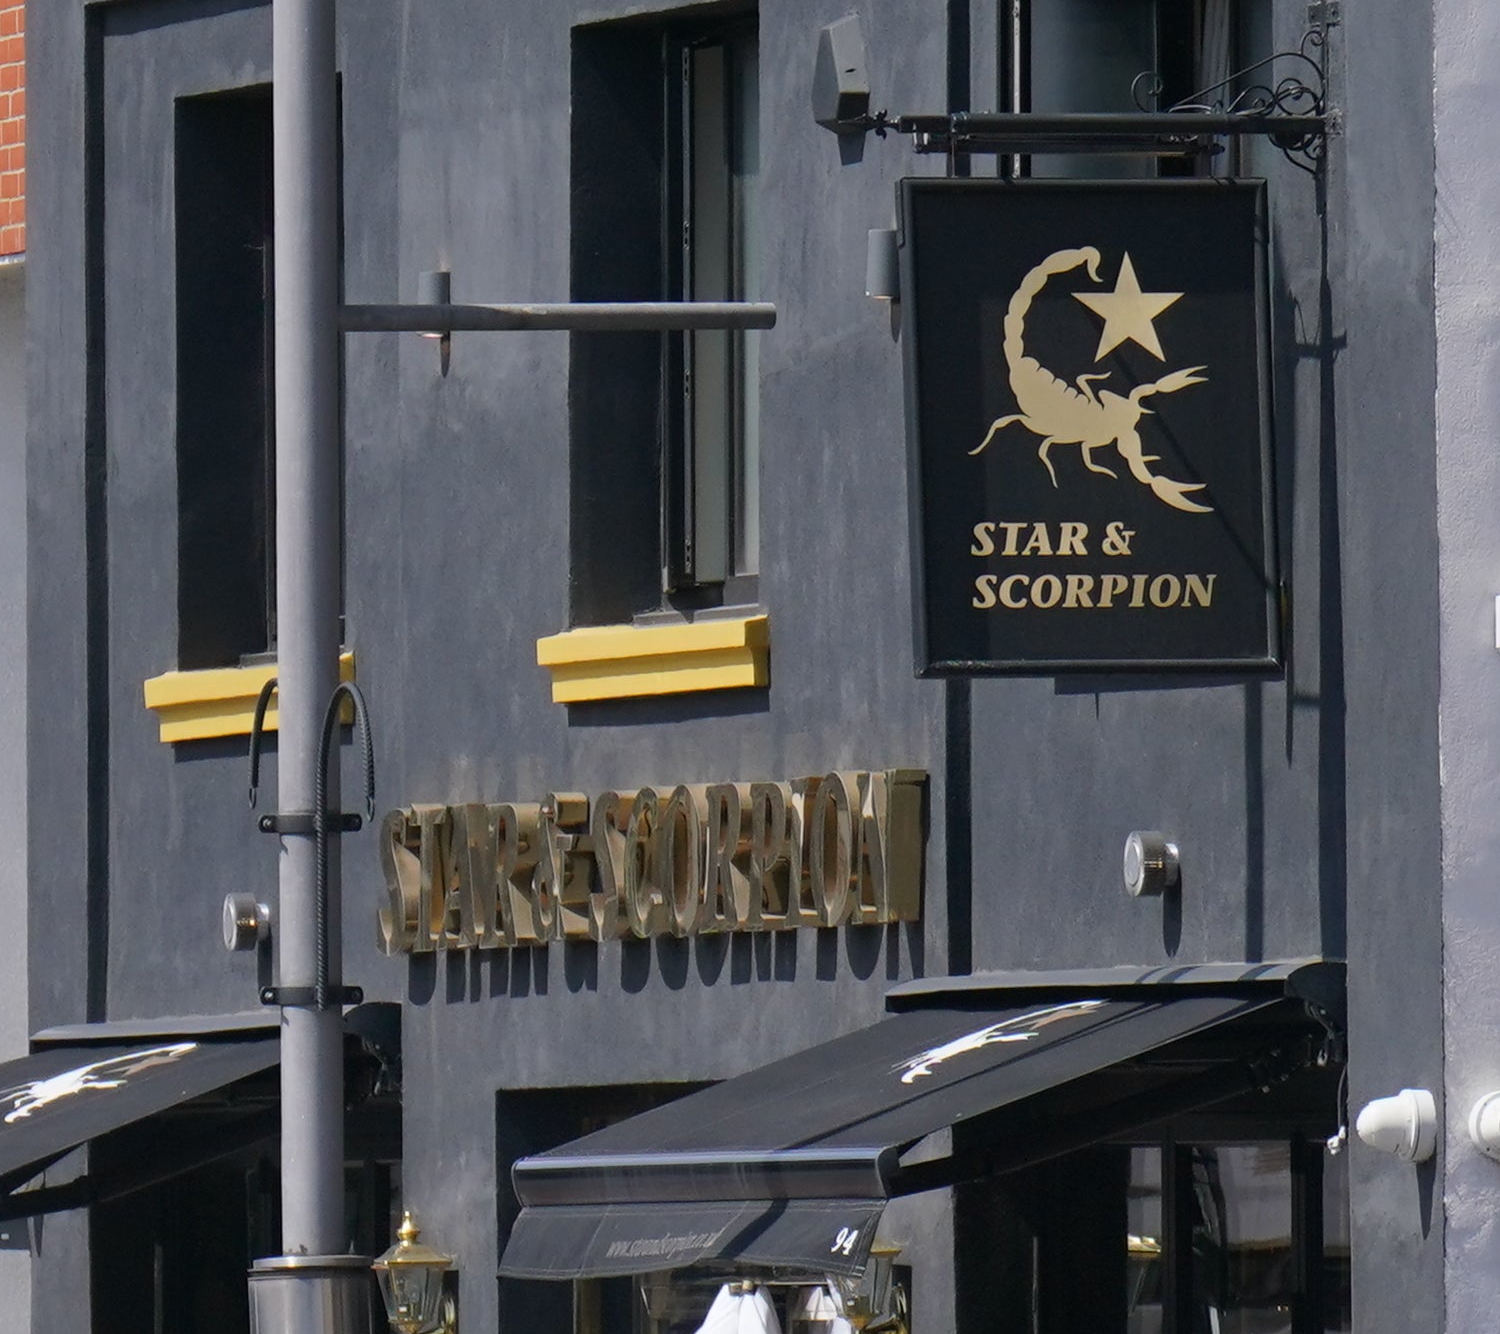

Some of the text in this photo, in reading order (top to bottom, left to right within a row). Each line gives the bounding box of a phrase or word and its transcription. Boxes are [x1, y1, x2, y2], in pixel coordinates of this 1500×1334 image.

[971, 521, 1136, 556] STAR &
[972, 573, 1217, 609] SCORPION
[377, 803, 533, 956] STAR
[590, 770, 926, 942] SCORPION
[830, 1227, 859, 1256] 94
